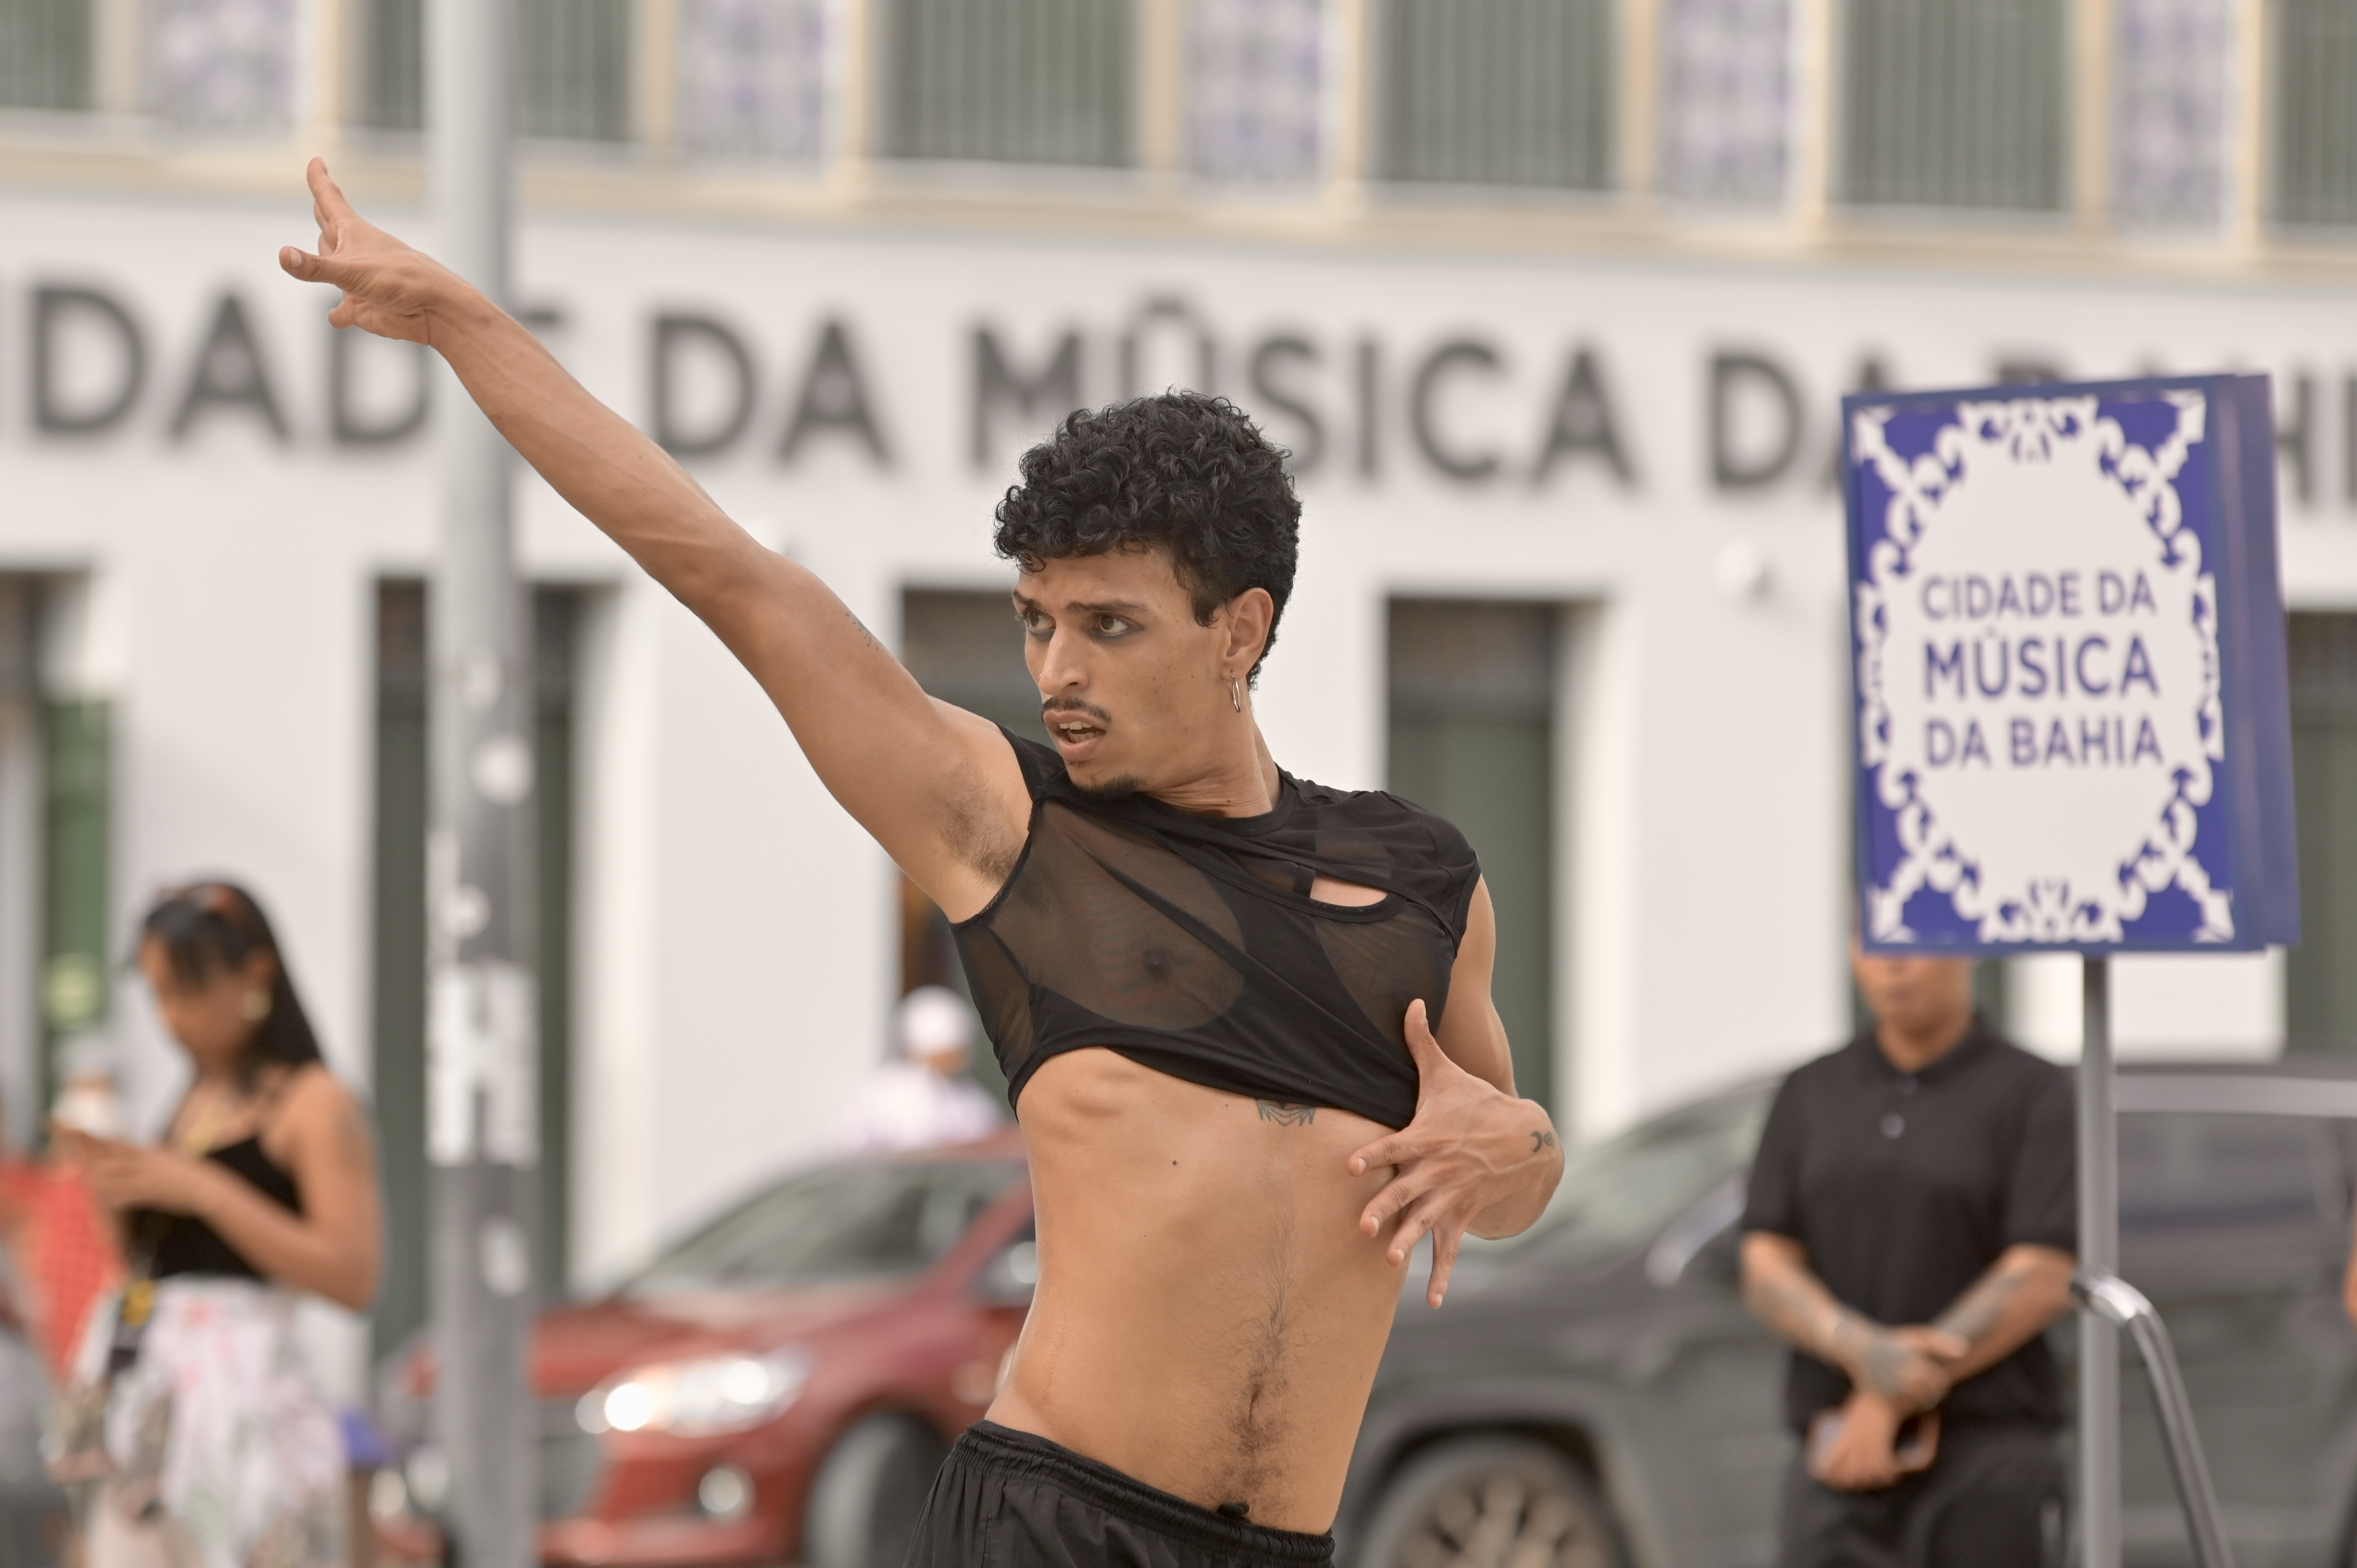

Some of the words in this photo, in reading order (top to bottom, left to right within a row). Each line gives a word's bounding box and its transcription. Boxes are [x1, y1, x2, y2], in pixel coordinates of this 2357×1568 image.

[0, 282, 565, 448] DAD
[647, 309, 893, 467] DA
[1922, 571, 2079, 620] CIDADE
[2097, 570, 2155, 615] DA
[1923, 626, 2159, 700] MÚSICA
[1925, 716, 1990, 767] DA
[2009, 715, 2162, 767] BAHIA
